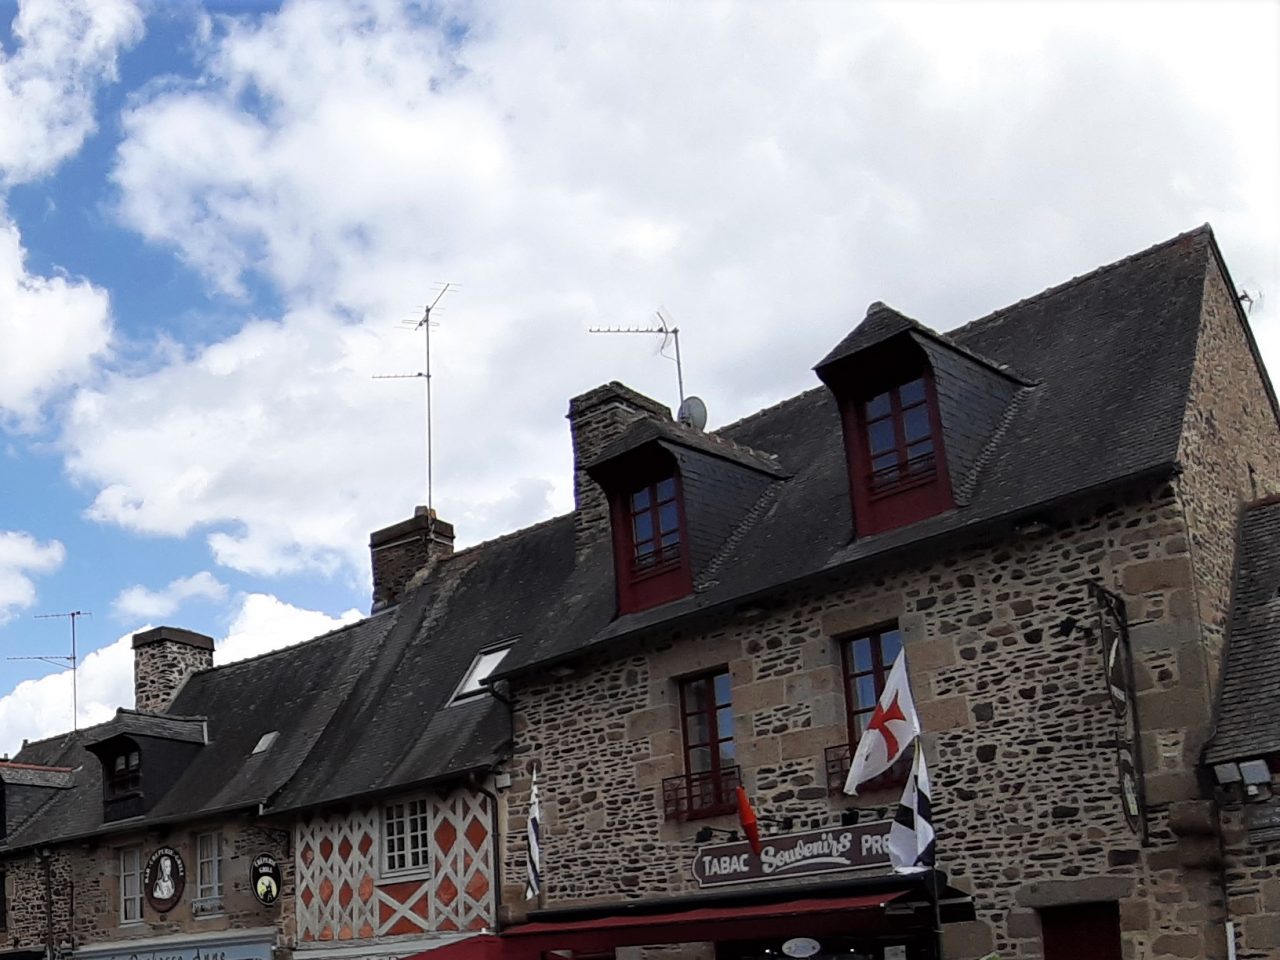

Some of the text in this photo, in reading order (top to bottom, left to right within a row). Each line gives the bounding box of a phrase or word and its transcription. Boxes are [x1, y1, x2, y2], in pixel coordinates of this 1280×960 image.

[701, 832, 890, 877] TABAC Souvenirs PRE
